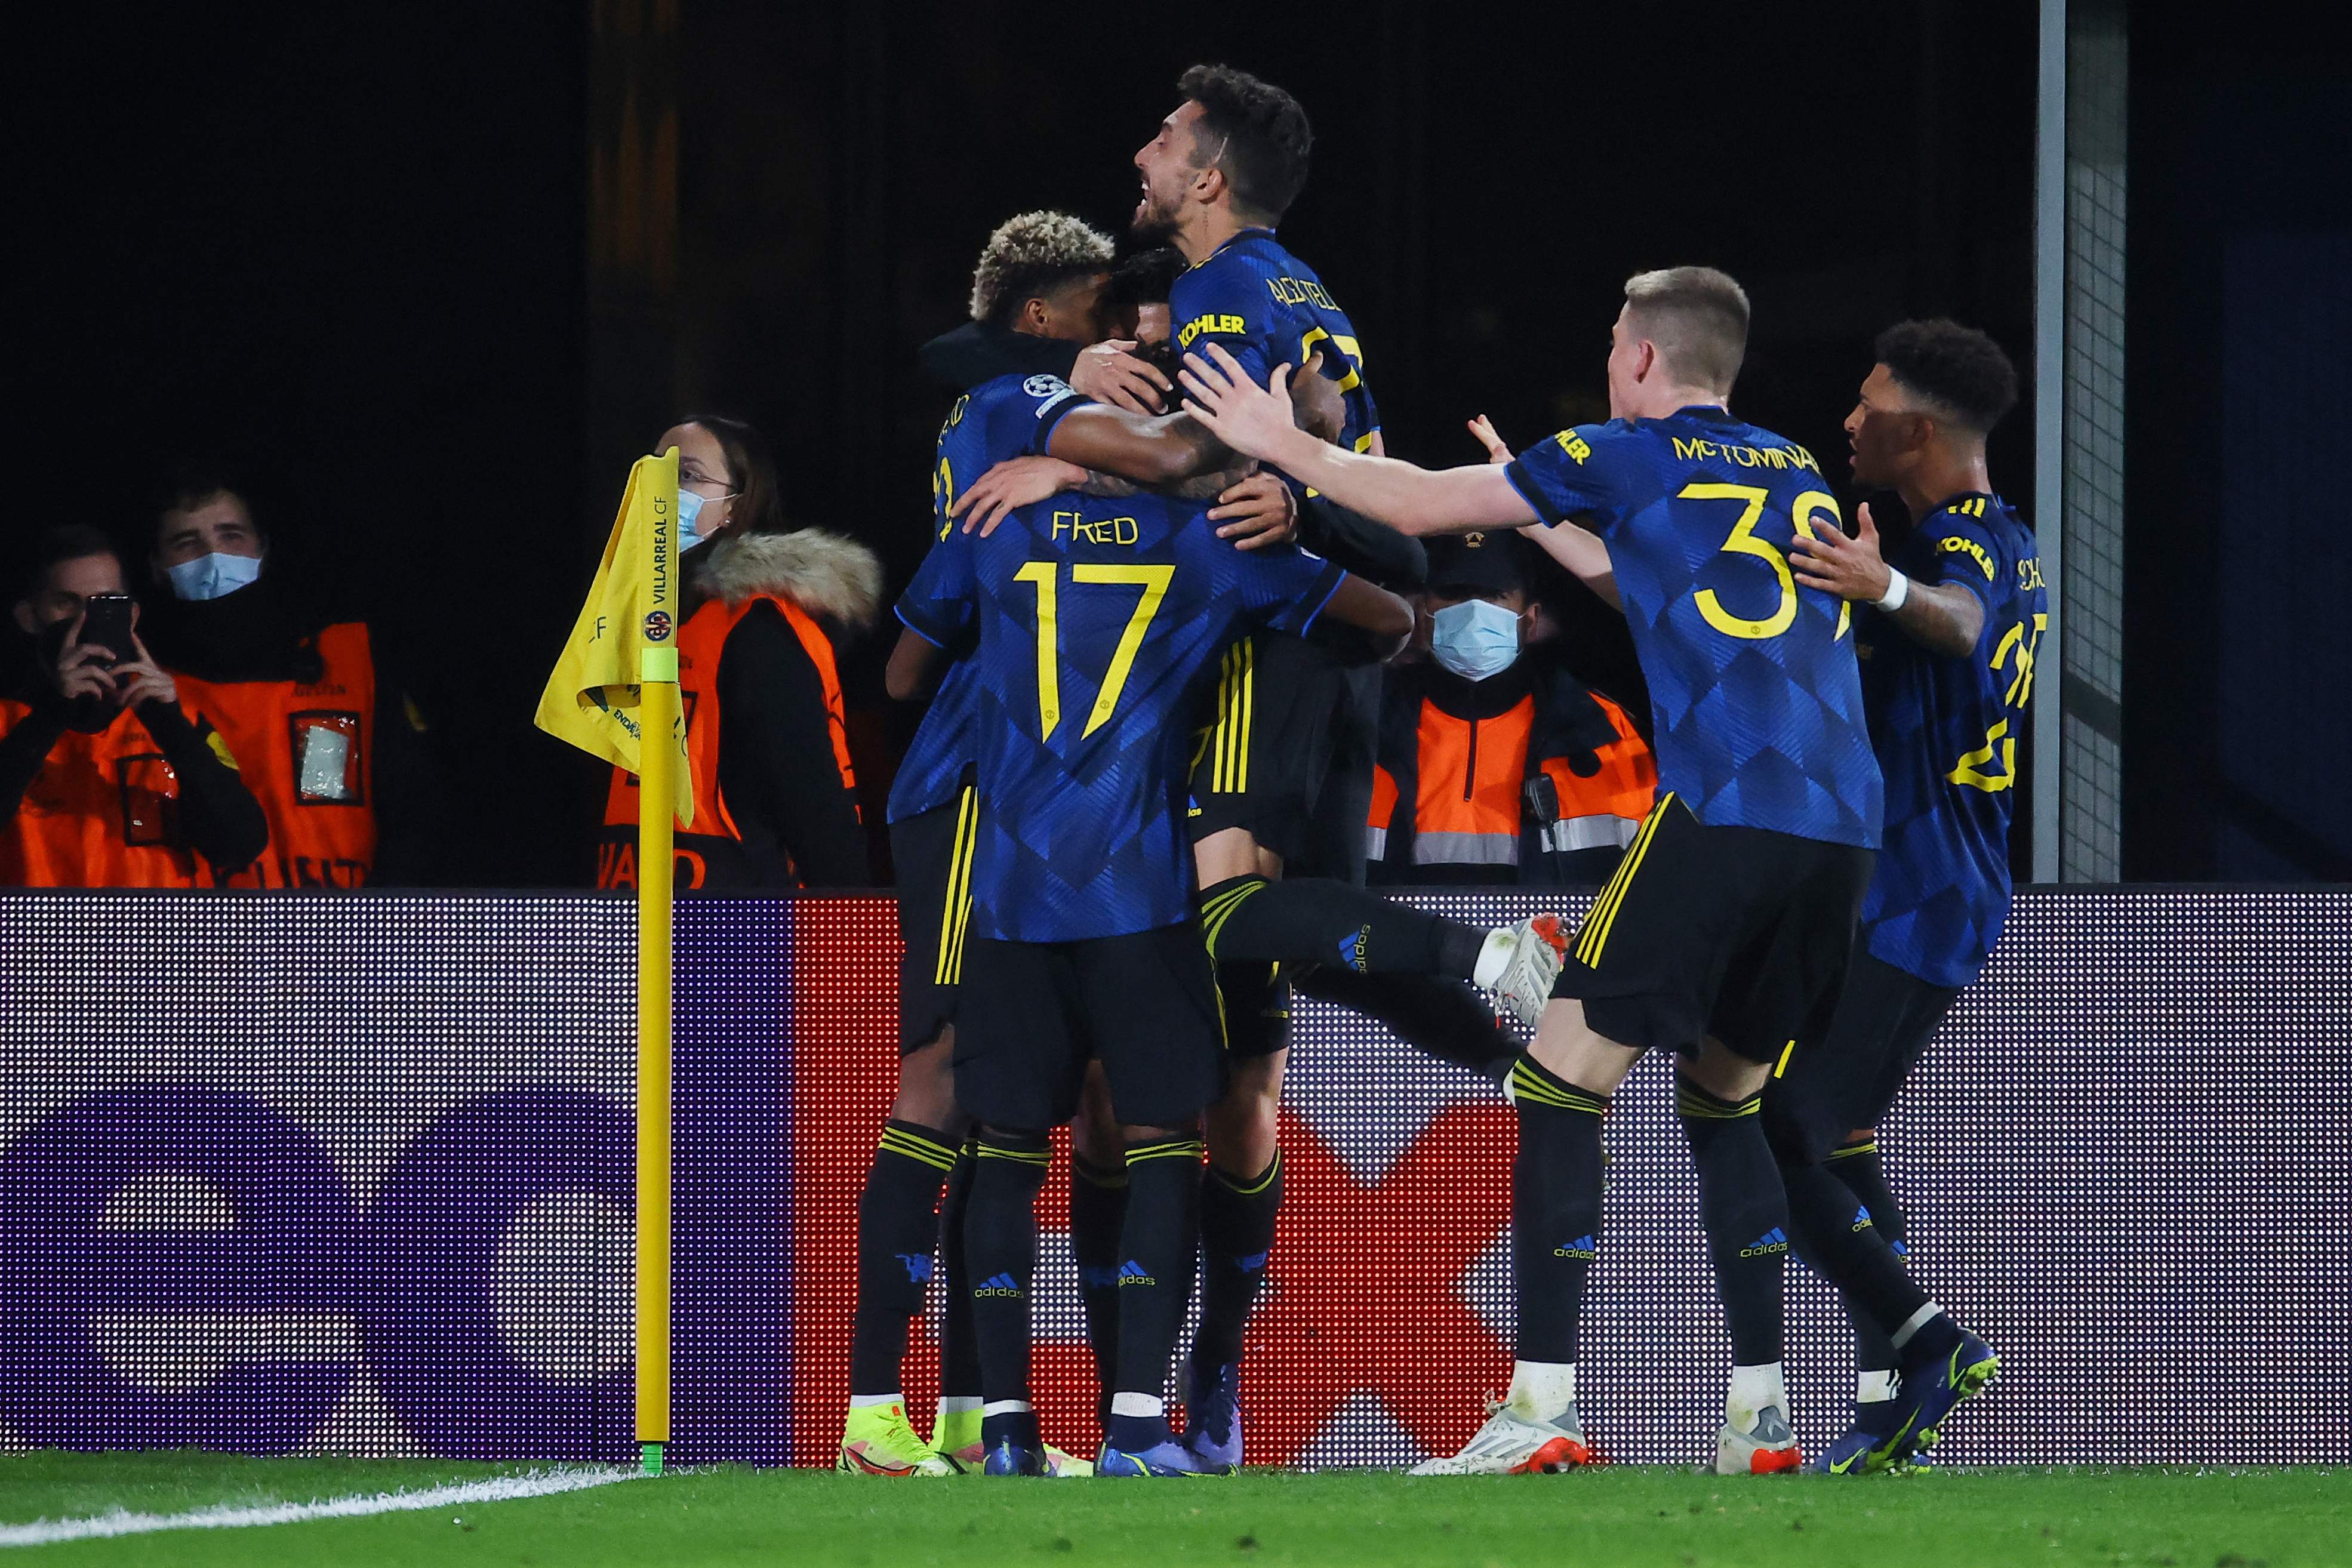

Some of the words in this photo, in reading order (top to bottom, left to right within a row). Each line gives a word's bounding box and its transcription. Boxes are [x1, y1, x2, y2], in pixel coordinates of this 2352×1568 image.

[1177, 314, 1246, 350] KOHLER
[1554, 427, 1591, 466] HLER
[654, 496, 667, 515] CF
[1052, 511, 1138, 544] FRED
[652, 518, 667, 605] VILLARREAL
[1013, 561, 1176, 744] 17
[1553, 1248, 1595, 1260] adidas
[1740, 1242, 1788, 1257] adidas
[974, 1286, 1024, 1298] adidas
